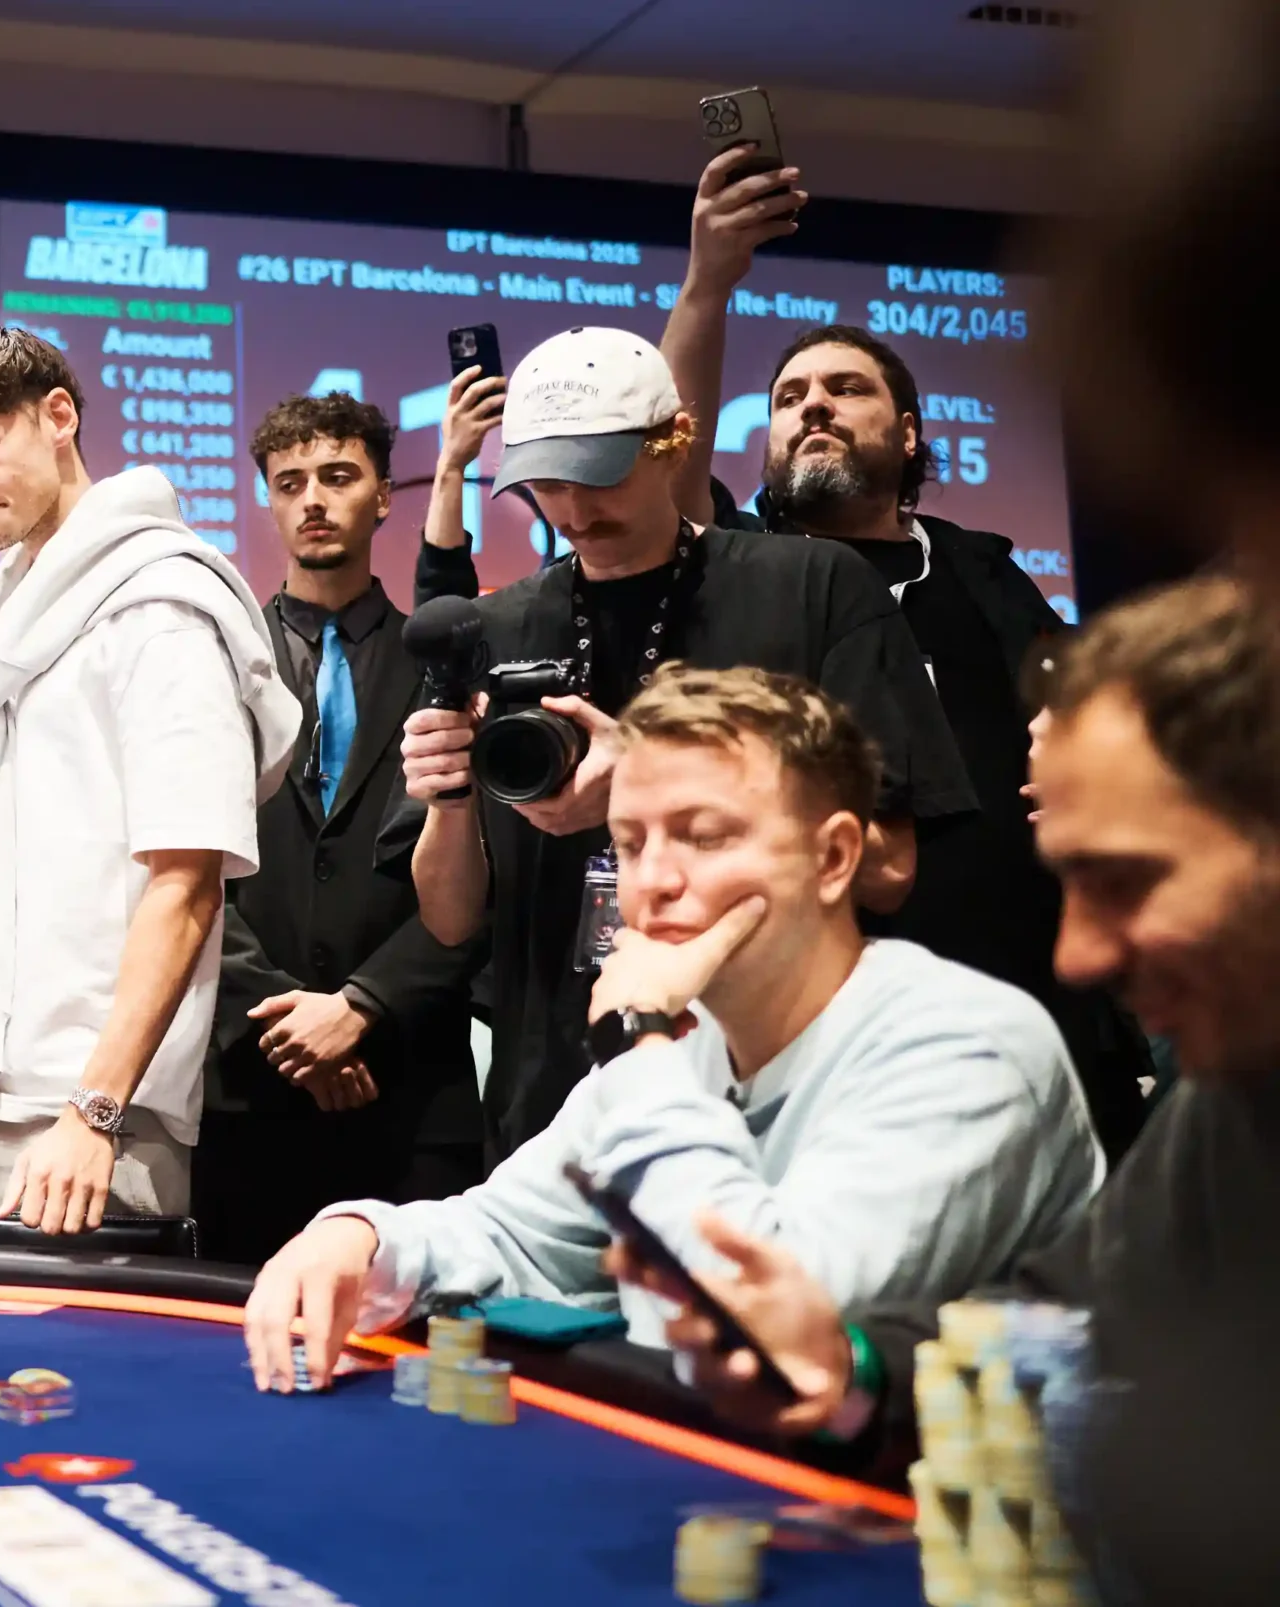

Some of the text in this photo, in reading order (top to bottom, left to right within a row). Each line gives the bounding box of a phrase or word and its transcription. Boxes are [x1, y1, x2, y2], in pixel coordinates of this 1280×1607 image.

[24, 235, 209, 291] BARCELONA
[447, 230, 641, 265] EPT Barcelona 2025
[237, 254, 290, 283] #26
[293, 257, 347, 287] EPT
[350, 261, 479, 297] Barcelona
[499, 271, 562, 302] Main
[565, 277, 636, 308] Event
[734, 289, 838, 326] Re-Entry
[887, 265, 1004, 297] PLAYERS:
[867, 299, 1028, 345] 304/2,045
[102, 327, 213, 360] Amount
[918, 394, 995, 424] LEVEL:
[930, 437, 988, 485] 15
[1011, 549, 1068, 577] ACK:
